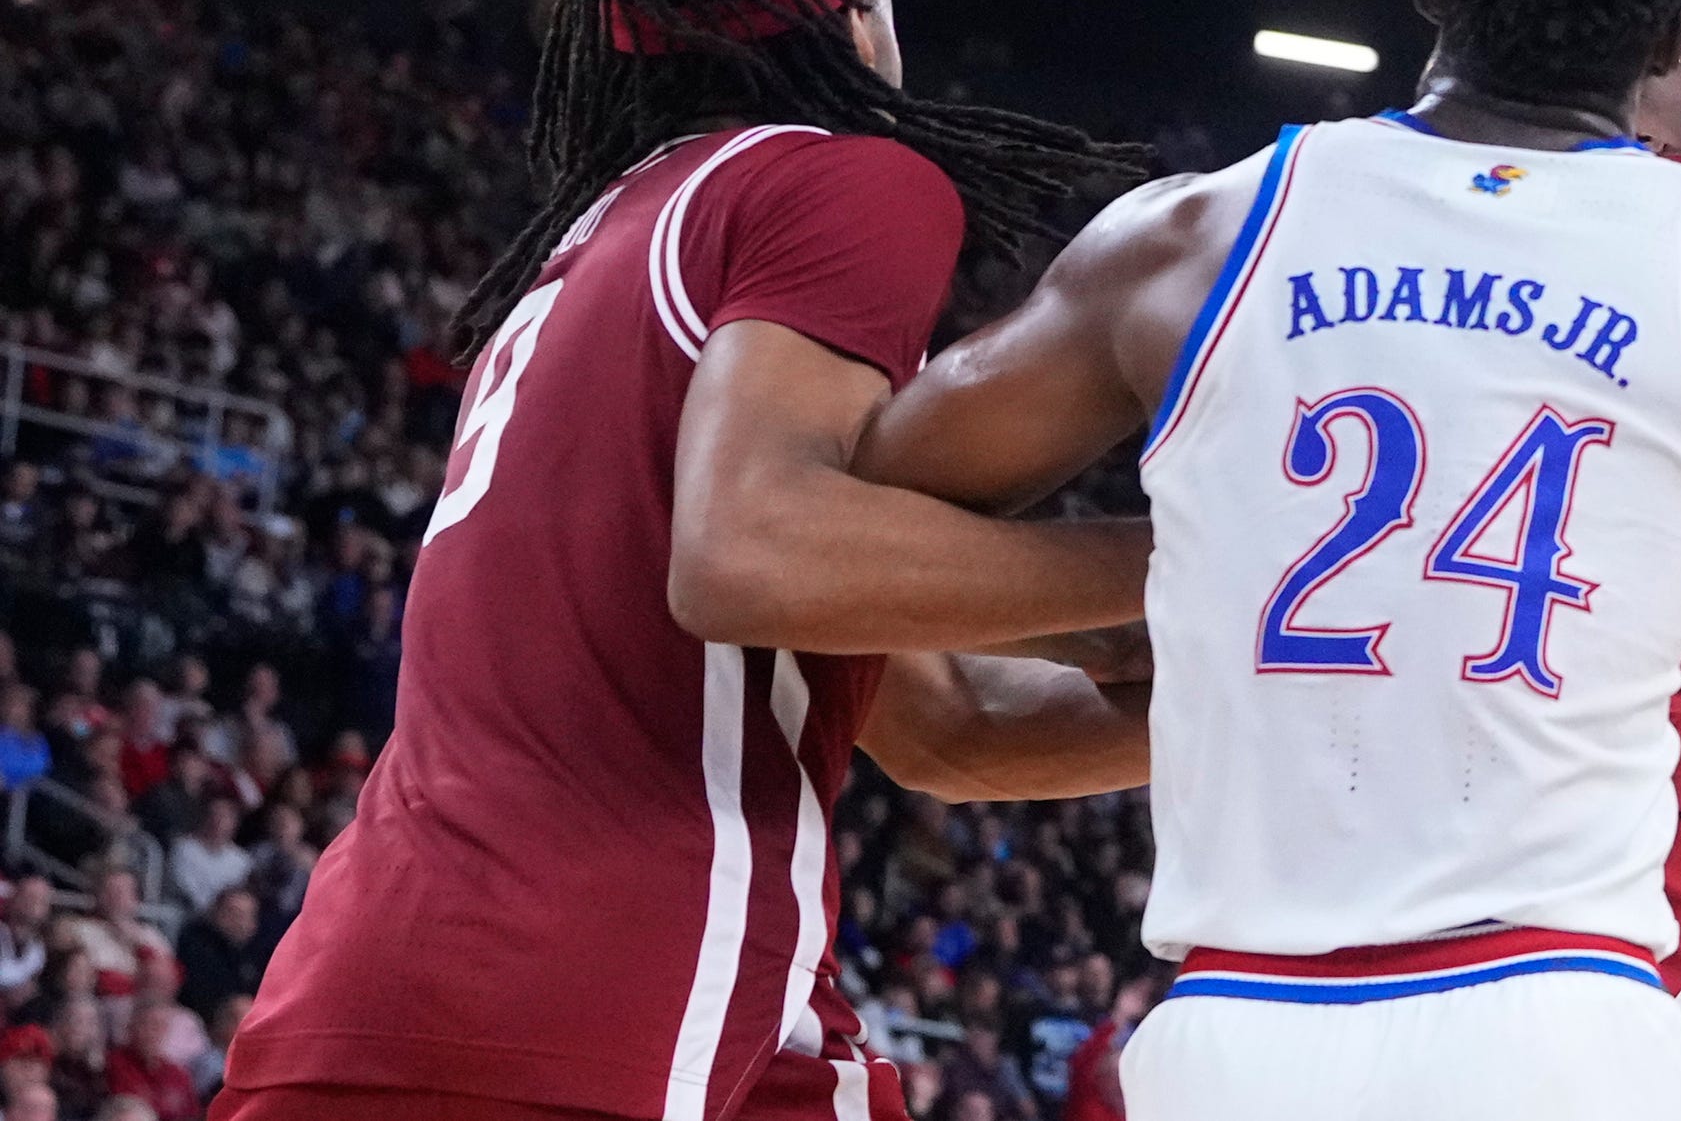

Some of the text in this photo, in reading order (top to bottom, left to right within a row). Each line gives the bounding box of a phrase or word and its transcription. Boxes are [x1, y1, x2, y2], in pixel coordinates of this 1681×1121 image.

[422, 277, 564, 548] 9
[1286, 266, 1639, 388] ADAMS JR.
[1256, 386, 1616, 700] 24
